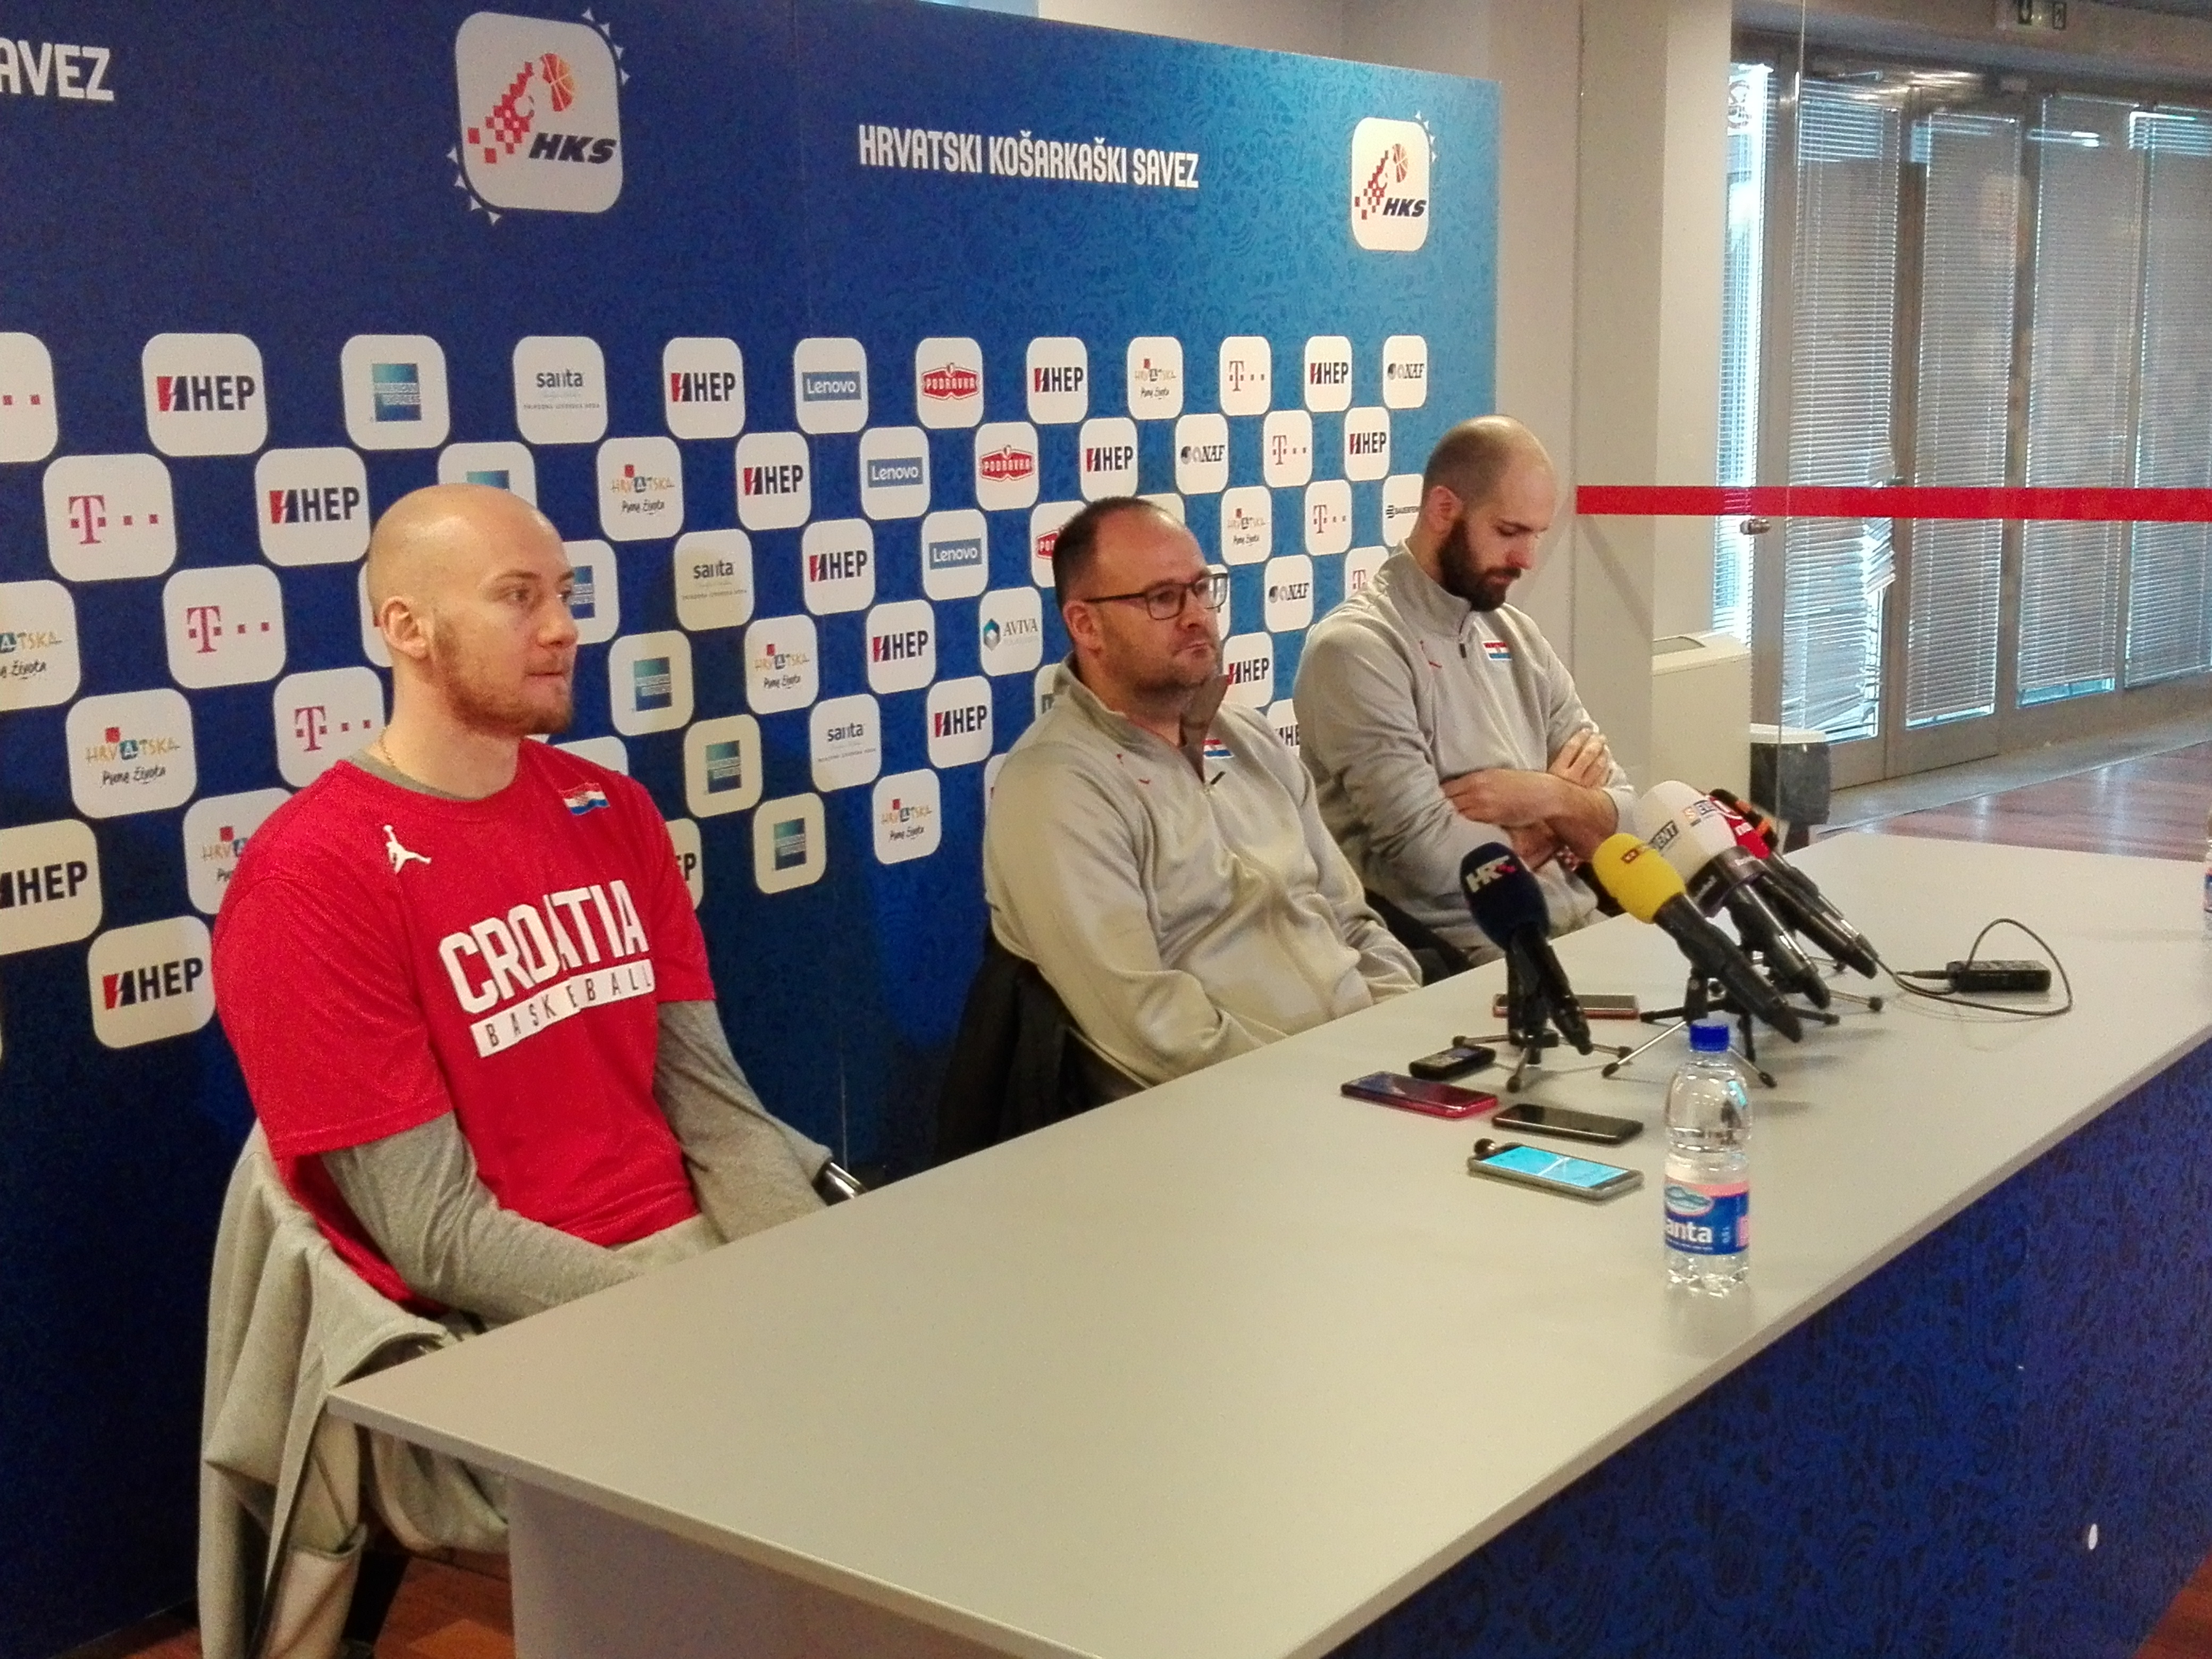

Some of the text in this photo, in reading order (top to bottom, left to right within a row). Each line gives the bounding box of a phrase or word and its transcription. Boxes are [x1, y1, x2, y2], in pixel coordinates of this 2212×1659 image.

[528, 132, 617, 164] HKS
[859, 124, 1199, 188] HRVATSKI KOŠARKAŠKI SAVEZ
[1382, 197, 1426, 217] HKS
[694, 372, 735, 402] HEP
[807, 379, 856, 395] Lenovo
[1051, 367, 1083, 392] HEP
[1323, 362, 1349, 384] HEP
[192, 375, 255, 411] HEP
[1362, 432, 1386, 454] HEP
[872, 464, 919, 481] Lenovo
[1102, 446, 1133, 472] HEP
[764, 465, 803, 495] HEP
[301, 487, 360, 523] HEP
[829, 550, 867, 580] HEP
[933, 545, 978, 563] Lenovo
[892, 630, 928, 660] HEP
[1243, 657, 1269, 682] HEP
[953, 705, 987, 735] HEP
[16, 860, 88, 906] HEP
[439, 880, 649, 1013] CROATIA
[138, 957, 203, 1002] HEP
